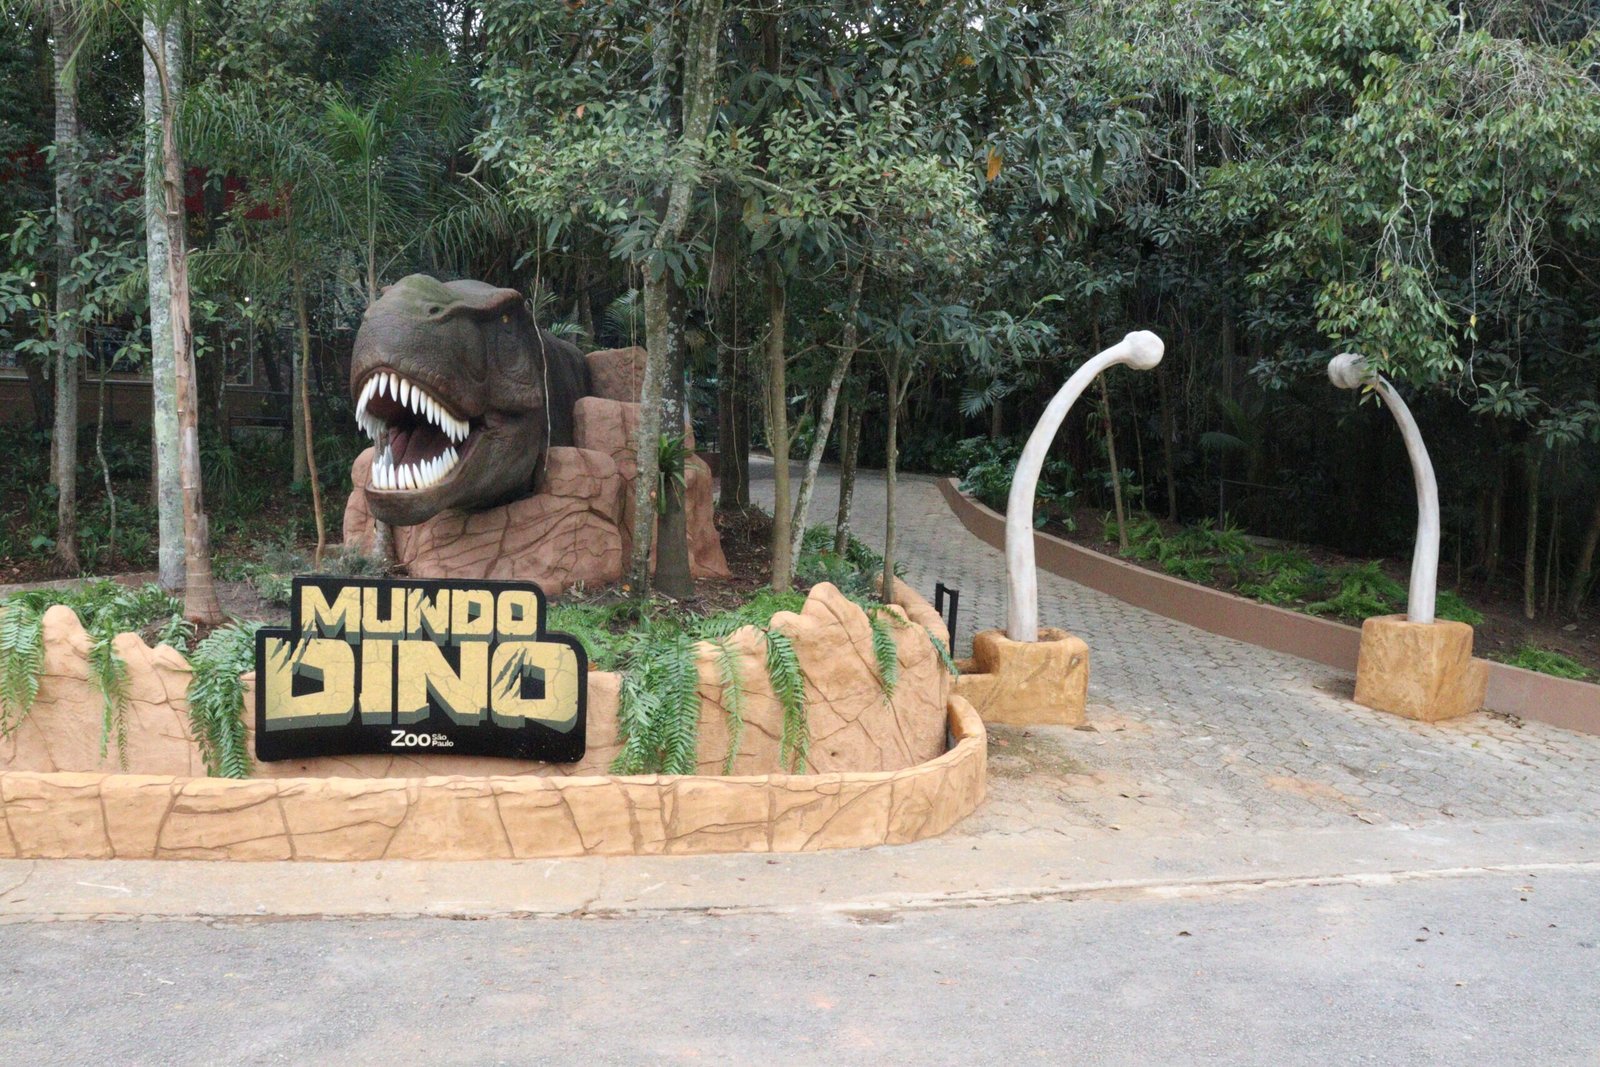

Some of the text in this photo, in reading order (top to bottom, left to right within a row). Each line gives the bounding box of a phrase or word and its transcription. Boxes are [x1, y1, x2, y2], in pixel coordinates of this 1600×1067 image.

[301, 585, 538, 638] MUNDO
[265, 637, 579, 727] DINO
[391, 729, 431, 747] Zoo
[431, 739, 454, 747] Paulo
